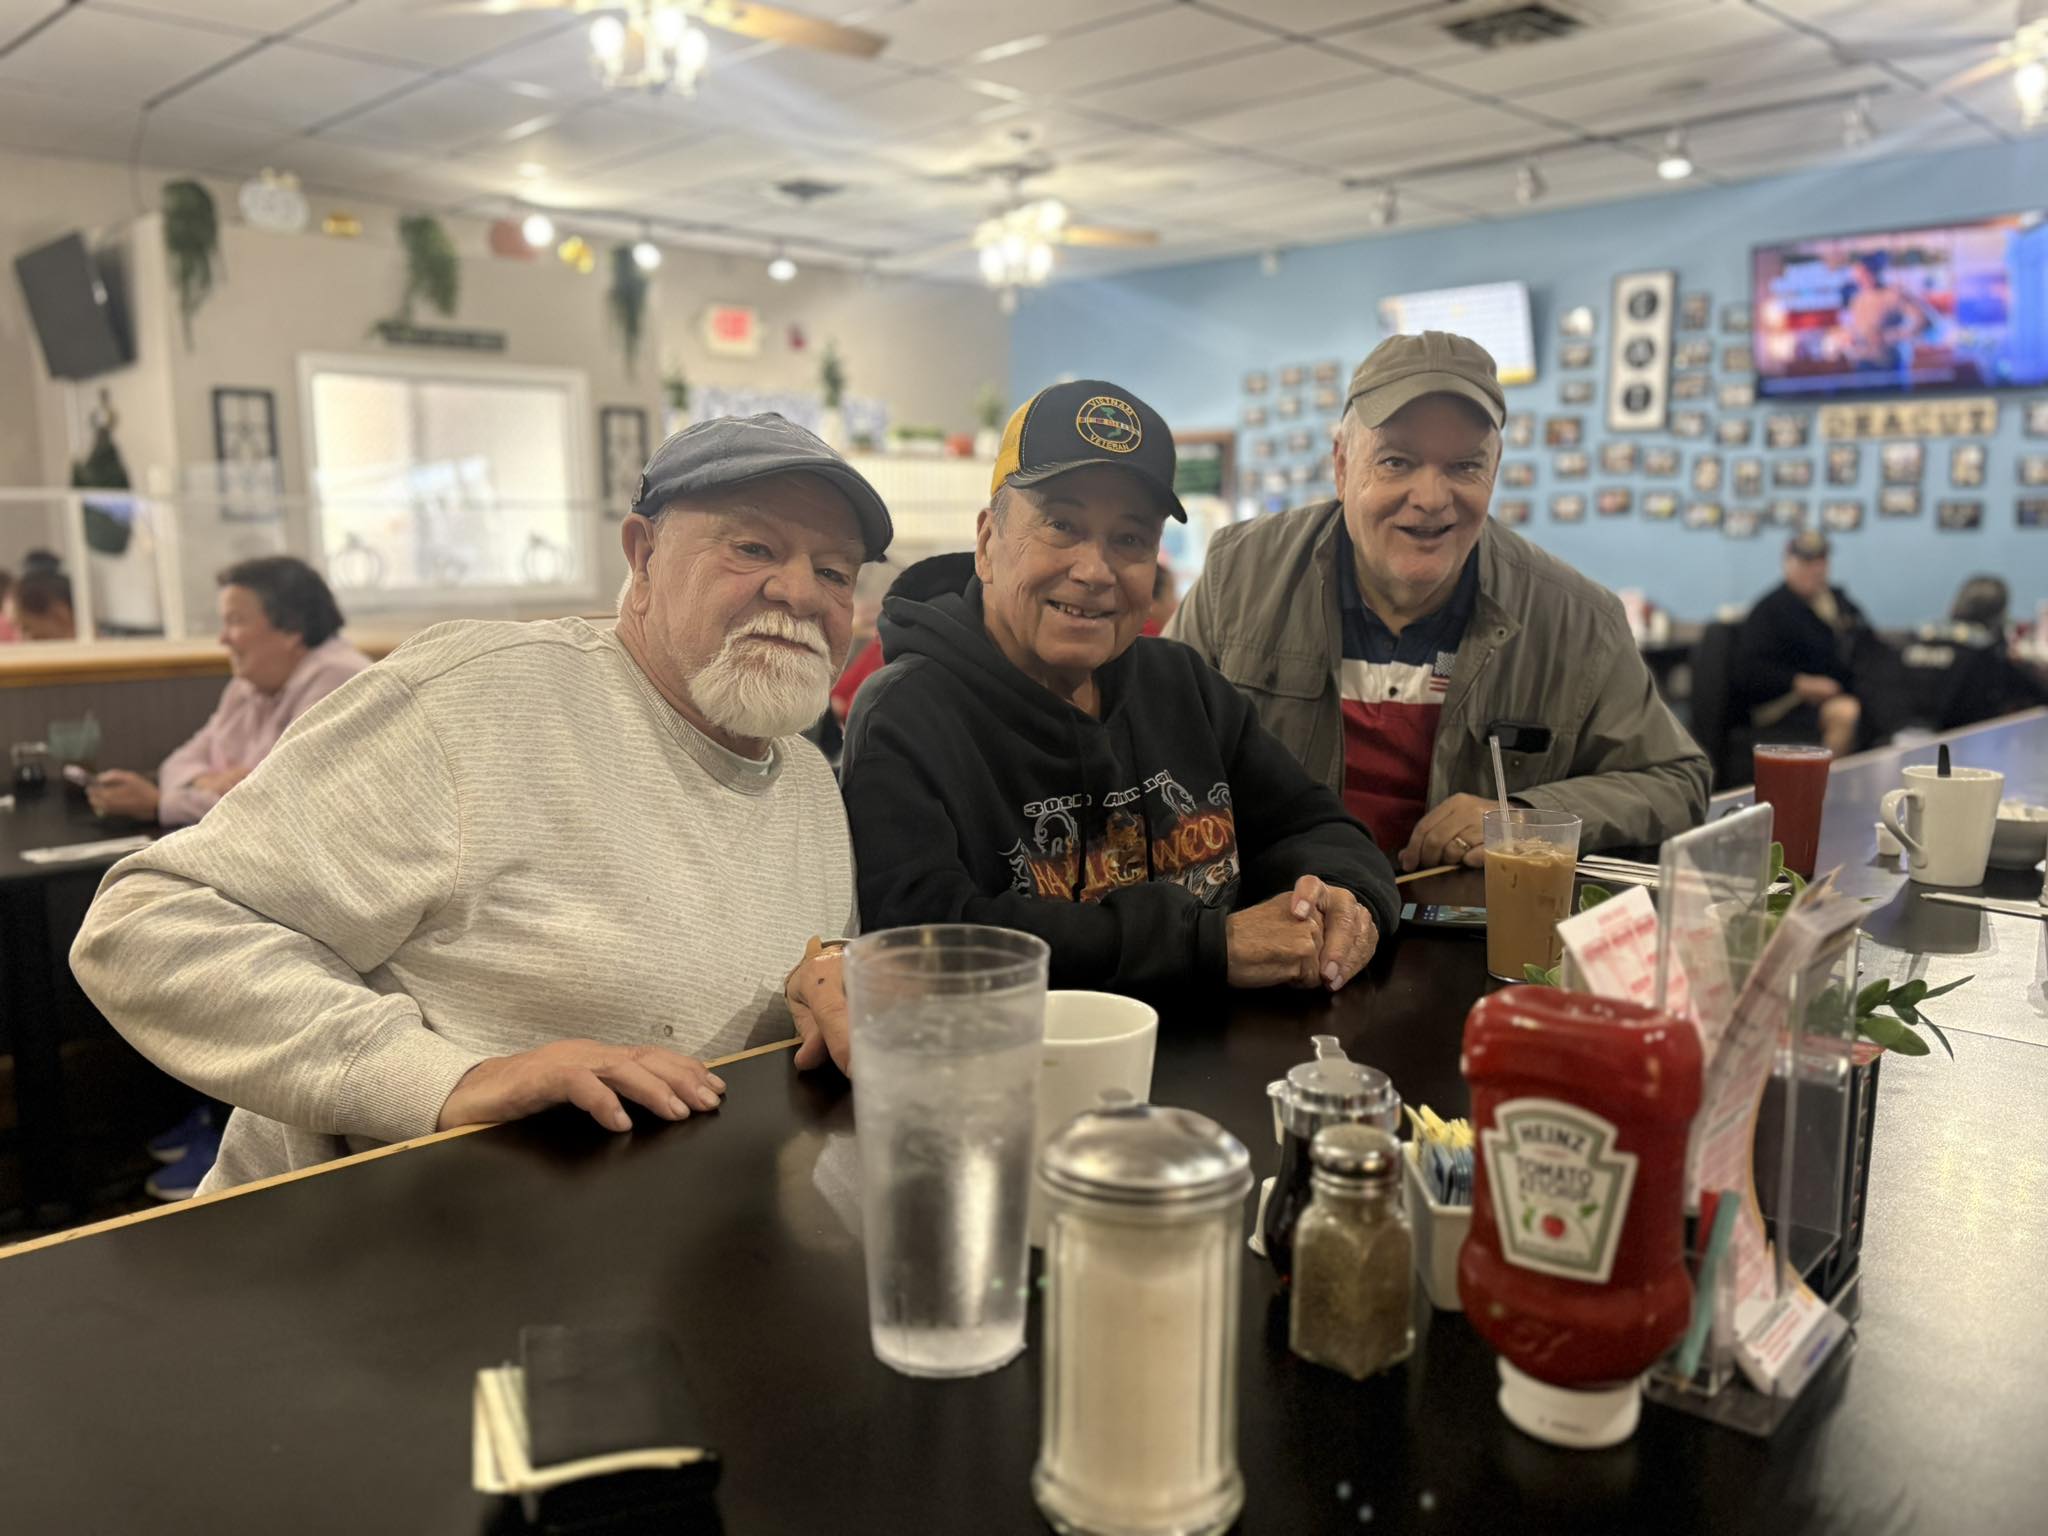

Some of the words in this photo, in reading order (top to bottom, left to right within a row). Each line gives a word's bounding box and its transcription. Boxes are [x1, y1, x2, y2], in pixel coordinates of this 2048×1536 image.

[1089, 397, 1134, 416] VIETNAM
[1089, 434, 1130, 451] VETERAN
[1519, 1125, 1586, 1152] HEINZ
[1517, 1156, 1593, 1187] TOMATO
